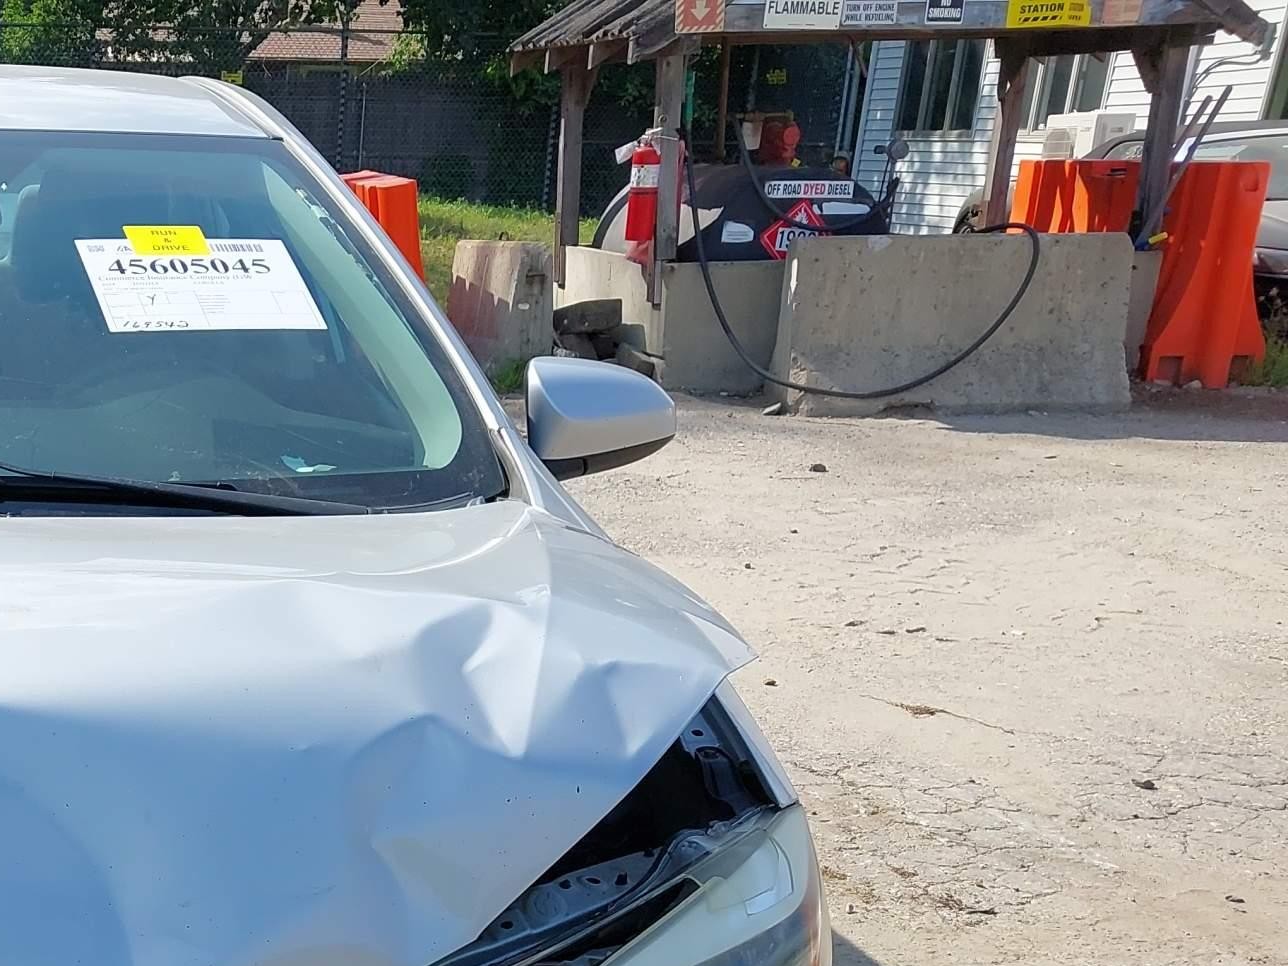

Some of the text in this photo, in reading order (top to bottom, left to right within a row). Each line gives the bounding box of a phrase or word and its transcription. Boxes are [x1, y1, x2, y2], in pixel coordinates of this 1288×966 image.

[767, 0, 840, 15] FLAMMABLE
[846, 3, 895, 12] TURN OFF ENGINE
[928, 7, 961, 18] SMOKING
[1019, 3, 1065, 14] STATION
[846, 13, 862, 22] WHILE
[767, 183, 851, 196] OFF ROAD DYED DIESEL
[108, 258, 272, 275] 45605045
